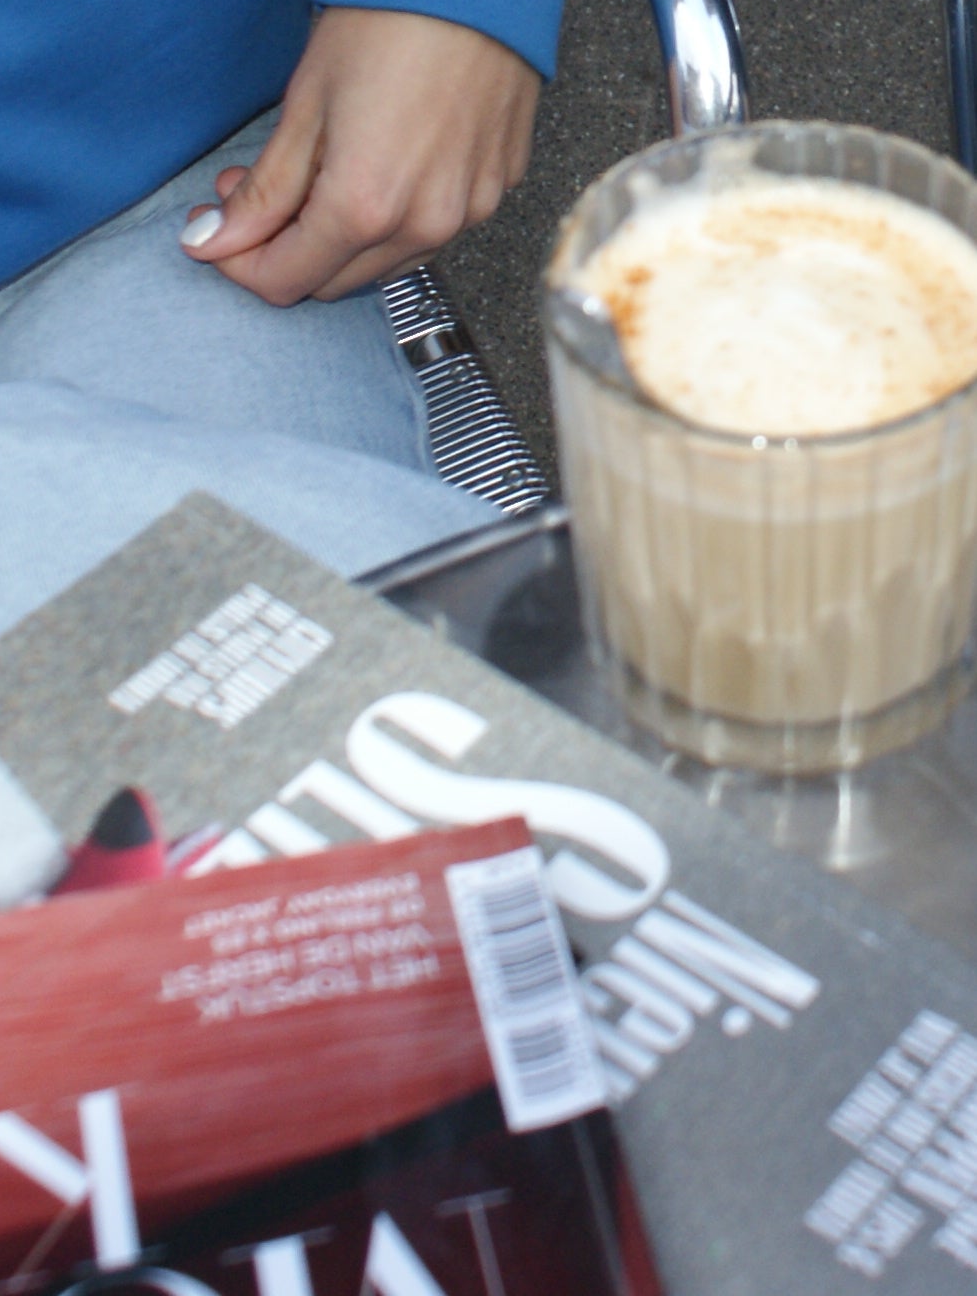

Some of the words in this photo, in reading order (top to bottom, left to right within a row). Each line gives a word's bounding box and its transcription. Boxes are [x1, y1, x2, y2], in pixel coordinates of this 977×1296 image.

[298, 932, 352, 967] DE
[353, 921, 434, 956] VAN
[160, 945, 296, 1002] HERFST
[370, 953, 440, 990] HET
[197, 964, 362, 1024] TOPSTUK
